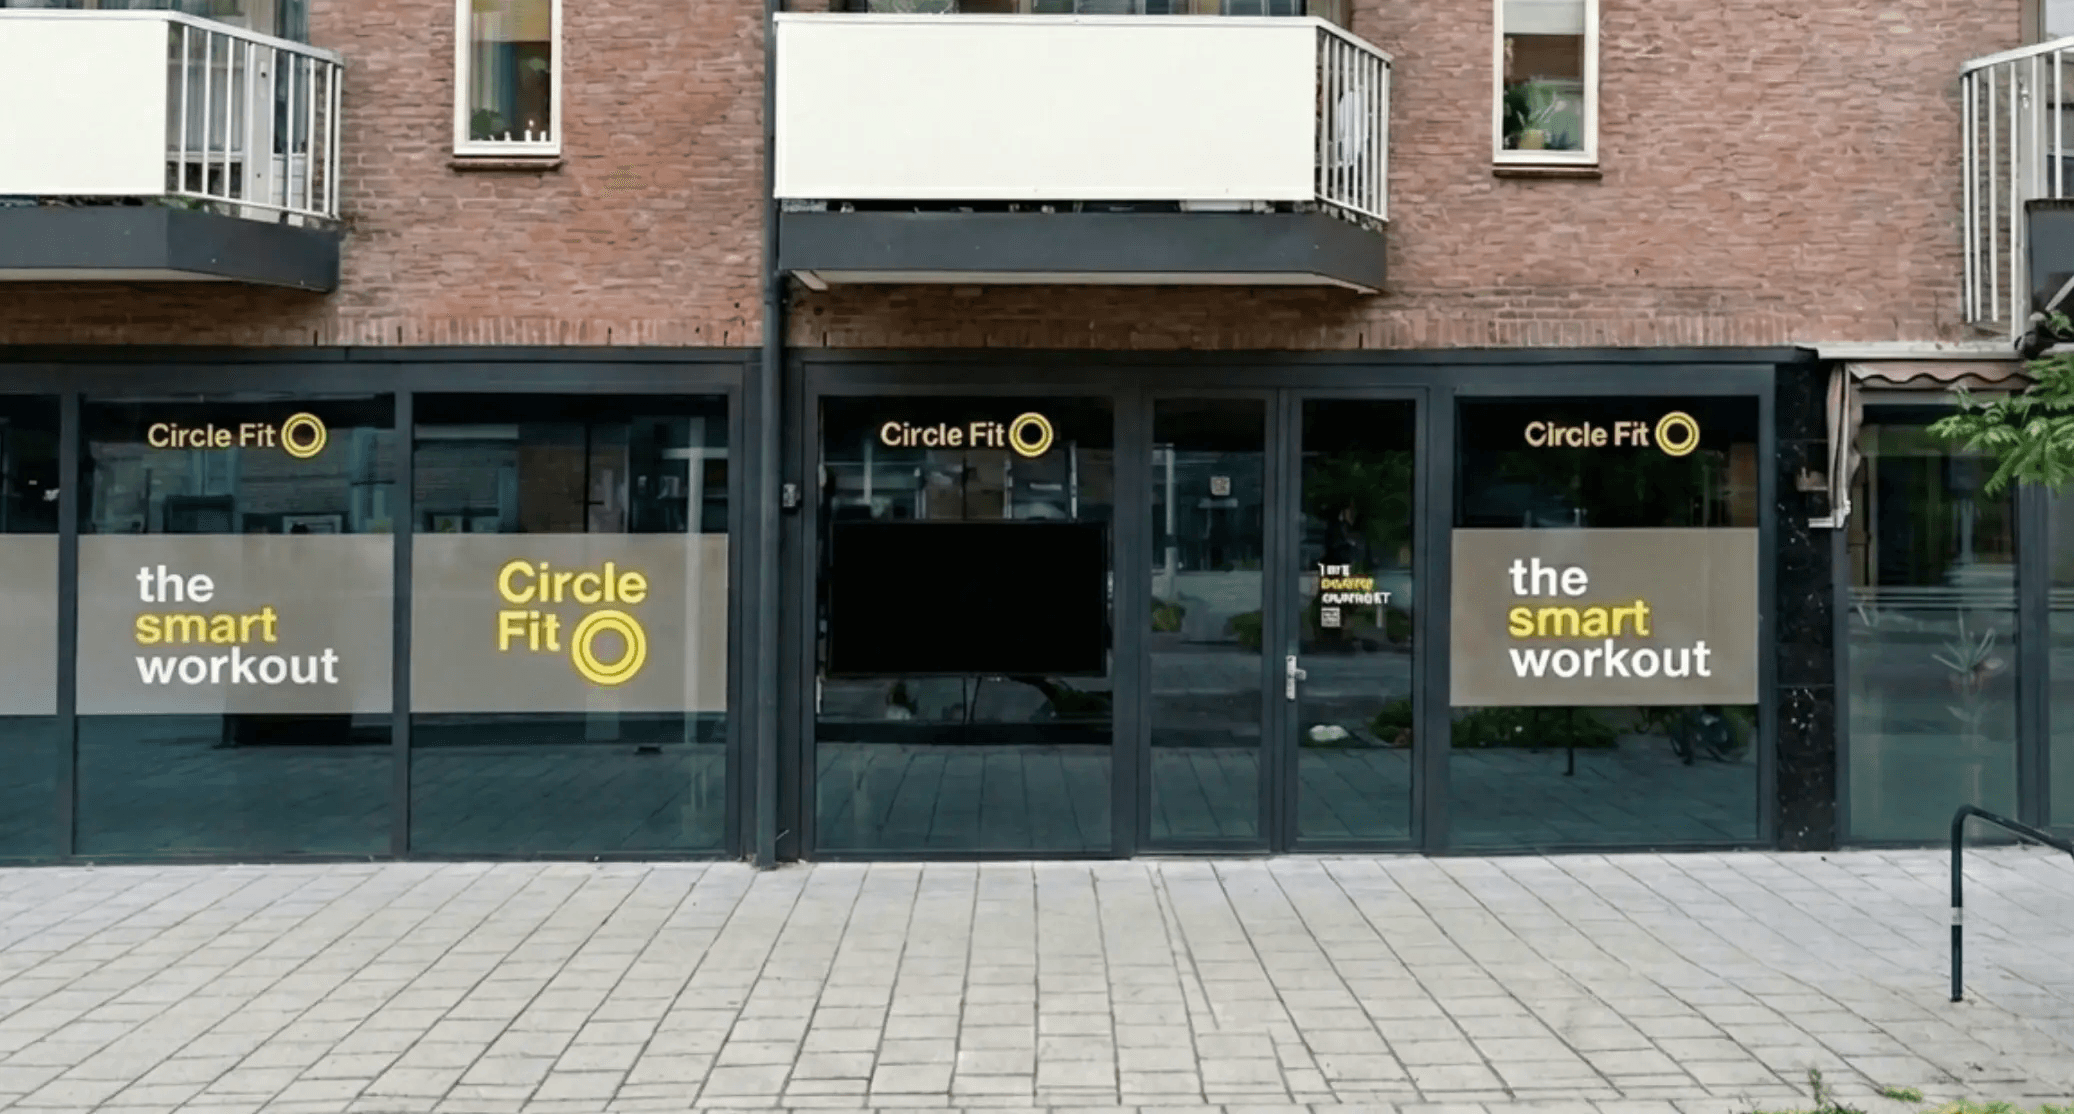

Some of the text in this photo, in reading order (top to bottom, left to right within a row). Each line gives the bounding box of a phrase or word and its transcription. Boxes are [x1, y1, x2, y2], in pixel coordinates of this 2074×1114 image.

[148, 423, 276, 447] Circle Fit
[881, 422, 1004, 446] Circle Fit
[1525, 421, 1649, 447] Circle Fit
[136, 564, 214, 603] the
[497, 560, 648, 605] Circle
[1509, 557, 1588, 596] the
[135, 607, 278, 645] smart
[497, 609, 562, 653] Fit
[1508, 600, 1650, 638] smart
[135, 646, 339, 684] workout
[1509, 639, 1711, 678] workout
